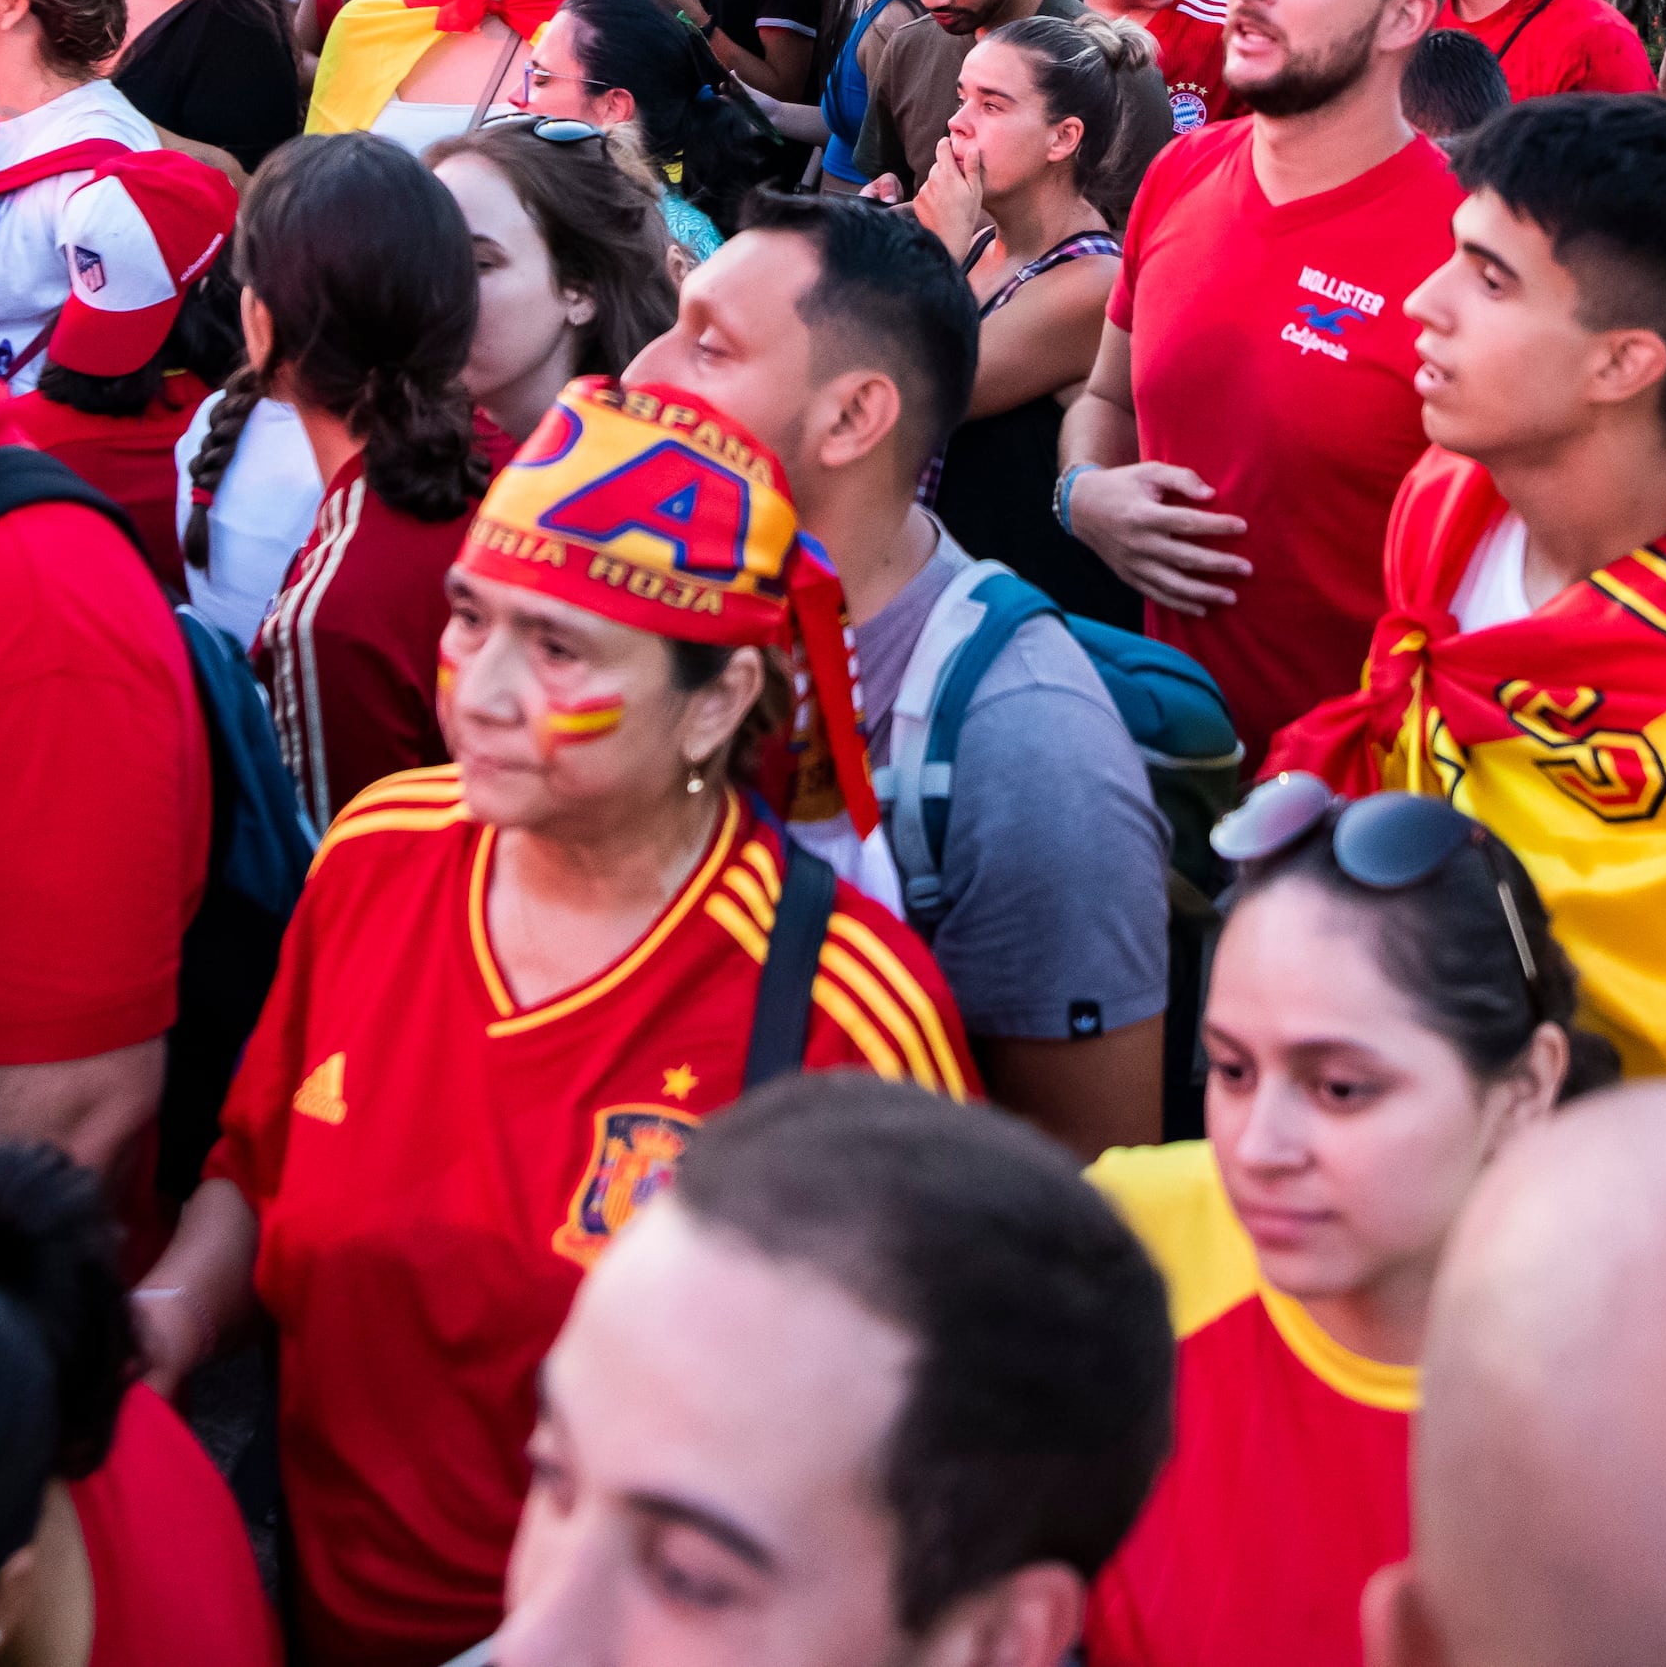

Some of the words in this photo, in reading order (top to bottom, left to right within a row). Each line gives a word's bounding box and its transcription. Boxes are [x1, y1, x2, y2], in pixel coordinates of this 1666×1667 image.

[1297, 265, 1385, 317] HOLLISTER
[1280, 322, 1349, 362] California
[470, 518, 567, 568] URIA
[588, 553, 724, 616] ROJA
